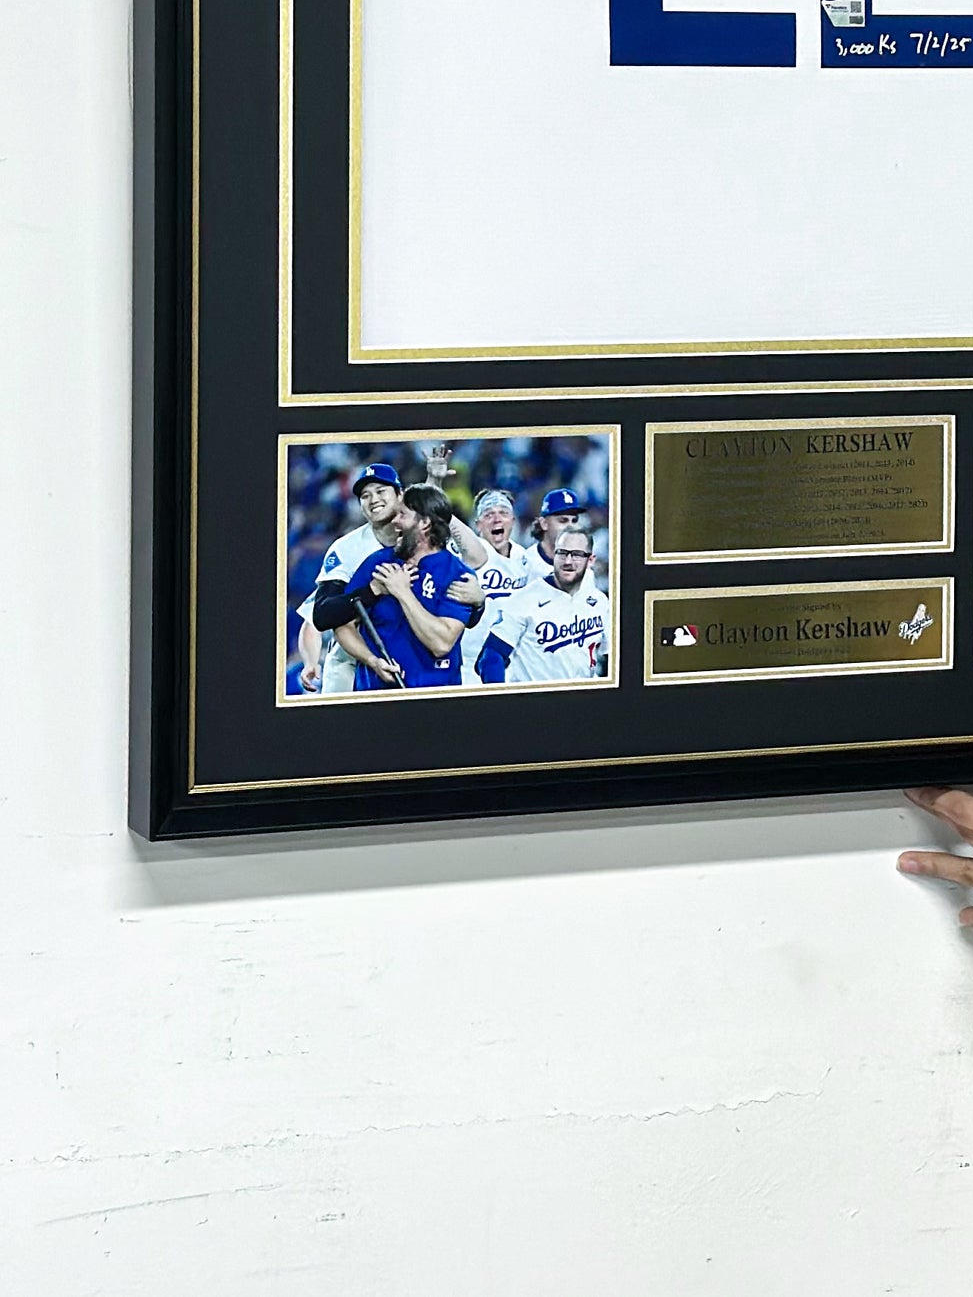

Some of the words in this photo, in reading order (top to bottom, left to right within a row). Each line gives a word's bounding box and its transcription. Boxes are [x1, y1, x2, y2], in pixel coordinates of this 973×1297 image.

[835, 37, 875, 56] 3,000
[879, 34, 896, 55] Ks
[909, 31, 972, 57] 7/2/25
[686, 436, 793, 459] CLAYTON
[806, 431, 914, 454] KERSHAW
[705, 622, 789, 650] Clayton
[796, 615, 892, 641] Kershaw
